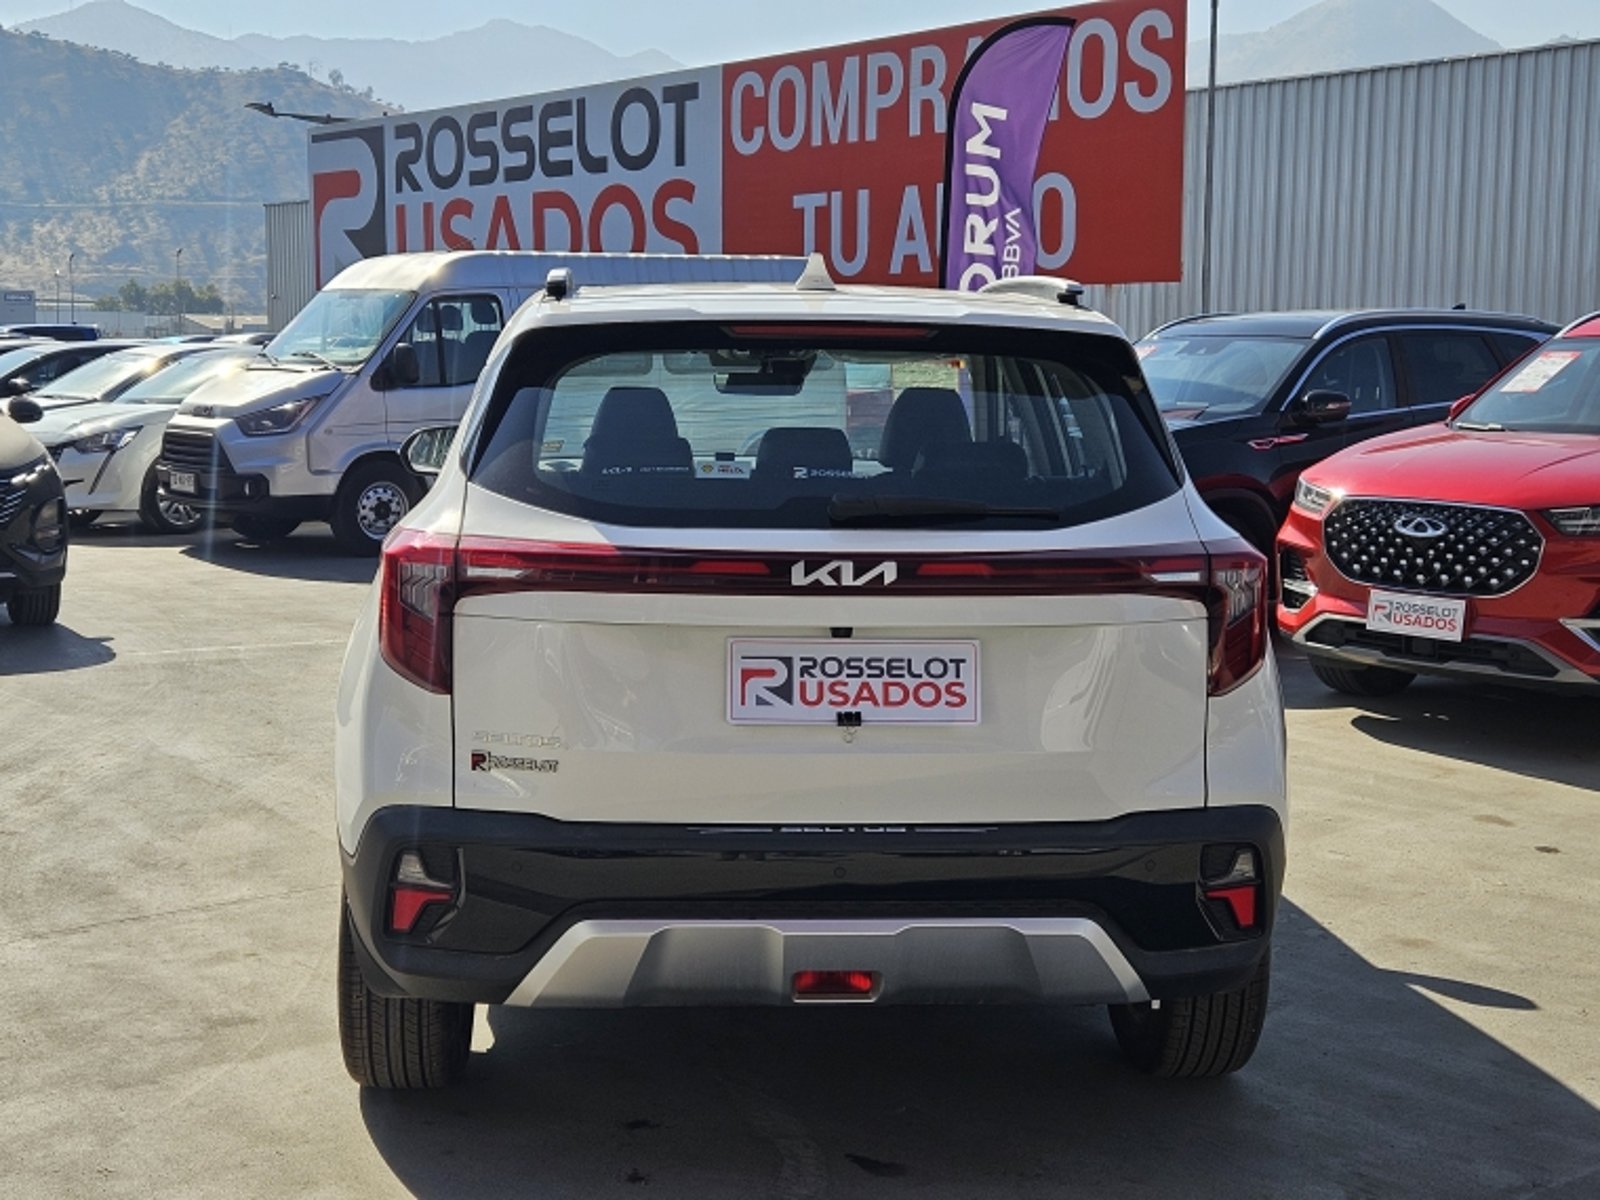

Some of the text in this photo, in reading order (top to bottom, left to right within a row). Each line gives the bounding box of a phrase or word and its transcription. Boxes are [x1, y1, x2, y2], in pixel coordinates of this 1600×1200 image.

[730, 9, 1174, 156] COMPROS
[395, 82, 699, 193] ROSSELOT
[395, 178, 699, 254] USADOS
[793, 172, 1077, 277] TU AO
[791, 560, 897, 586] KIA
[1393, 613, 1457, 632] USADOS
[1395, 602, 1458, 618] ROSSELOT
[800, 656, 967, 679] ROSSELOT
[800, 681, 967, 708] USADOS
